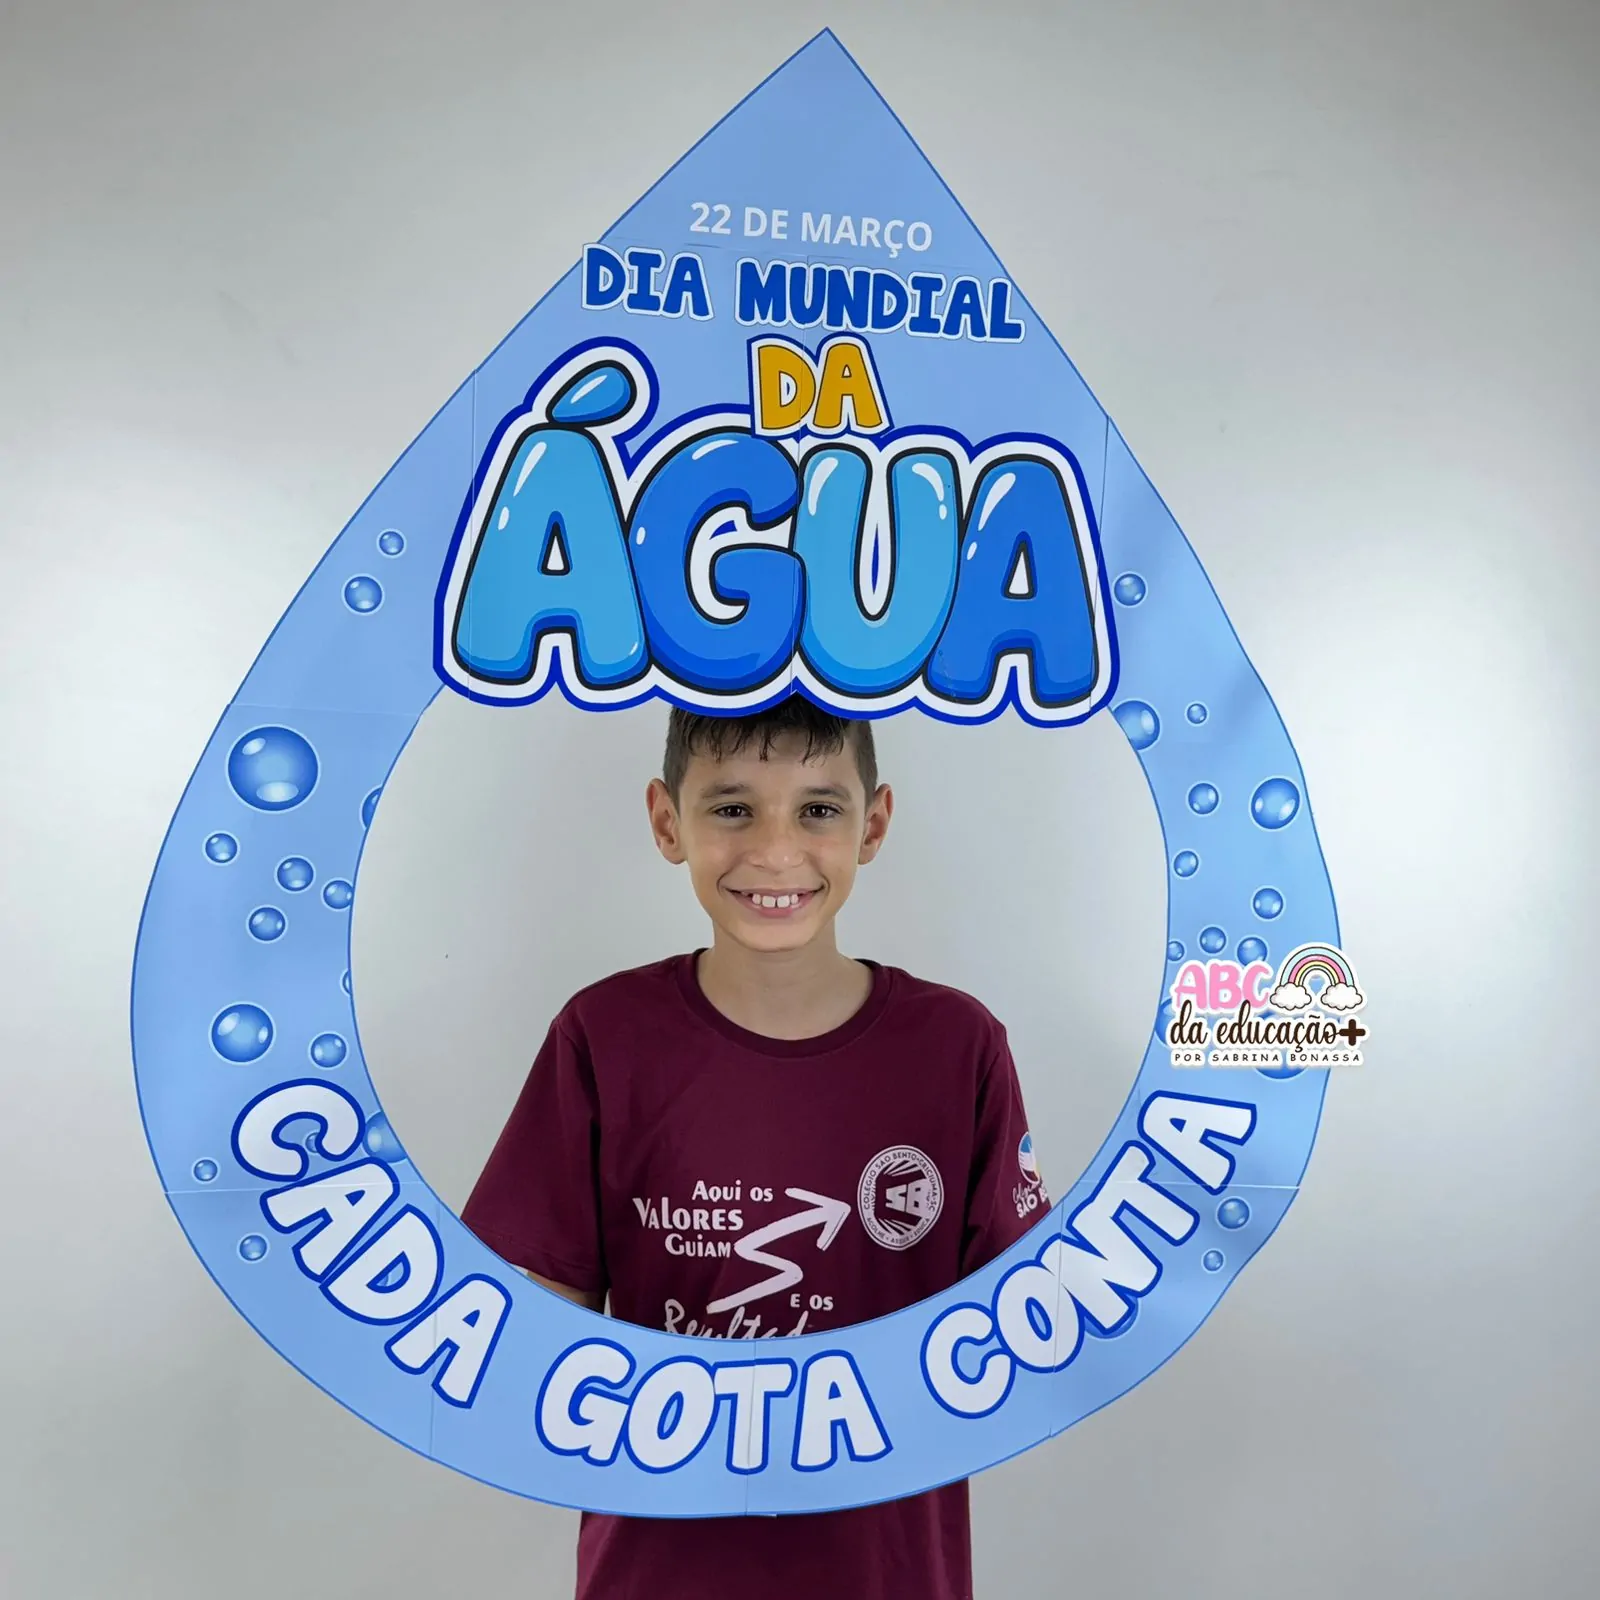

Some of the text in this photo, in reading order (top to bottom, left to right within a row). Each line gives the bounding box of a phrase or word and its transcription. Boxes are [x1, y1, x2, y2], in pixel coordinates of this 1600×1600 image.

[689, 202, 933, 258] 22 DE MARÇO
[583, 245, 1025, 342] DIA MUNDIAL
[752, 338, 888, 433] DA
[436, 340, 1118, 724] ÁGUA
[231, 1078, 1257, 1475] CADA GOTA CONTA
[790, 1293, 800, 1308] E
